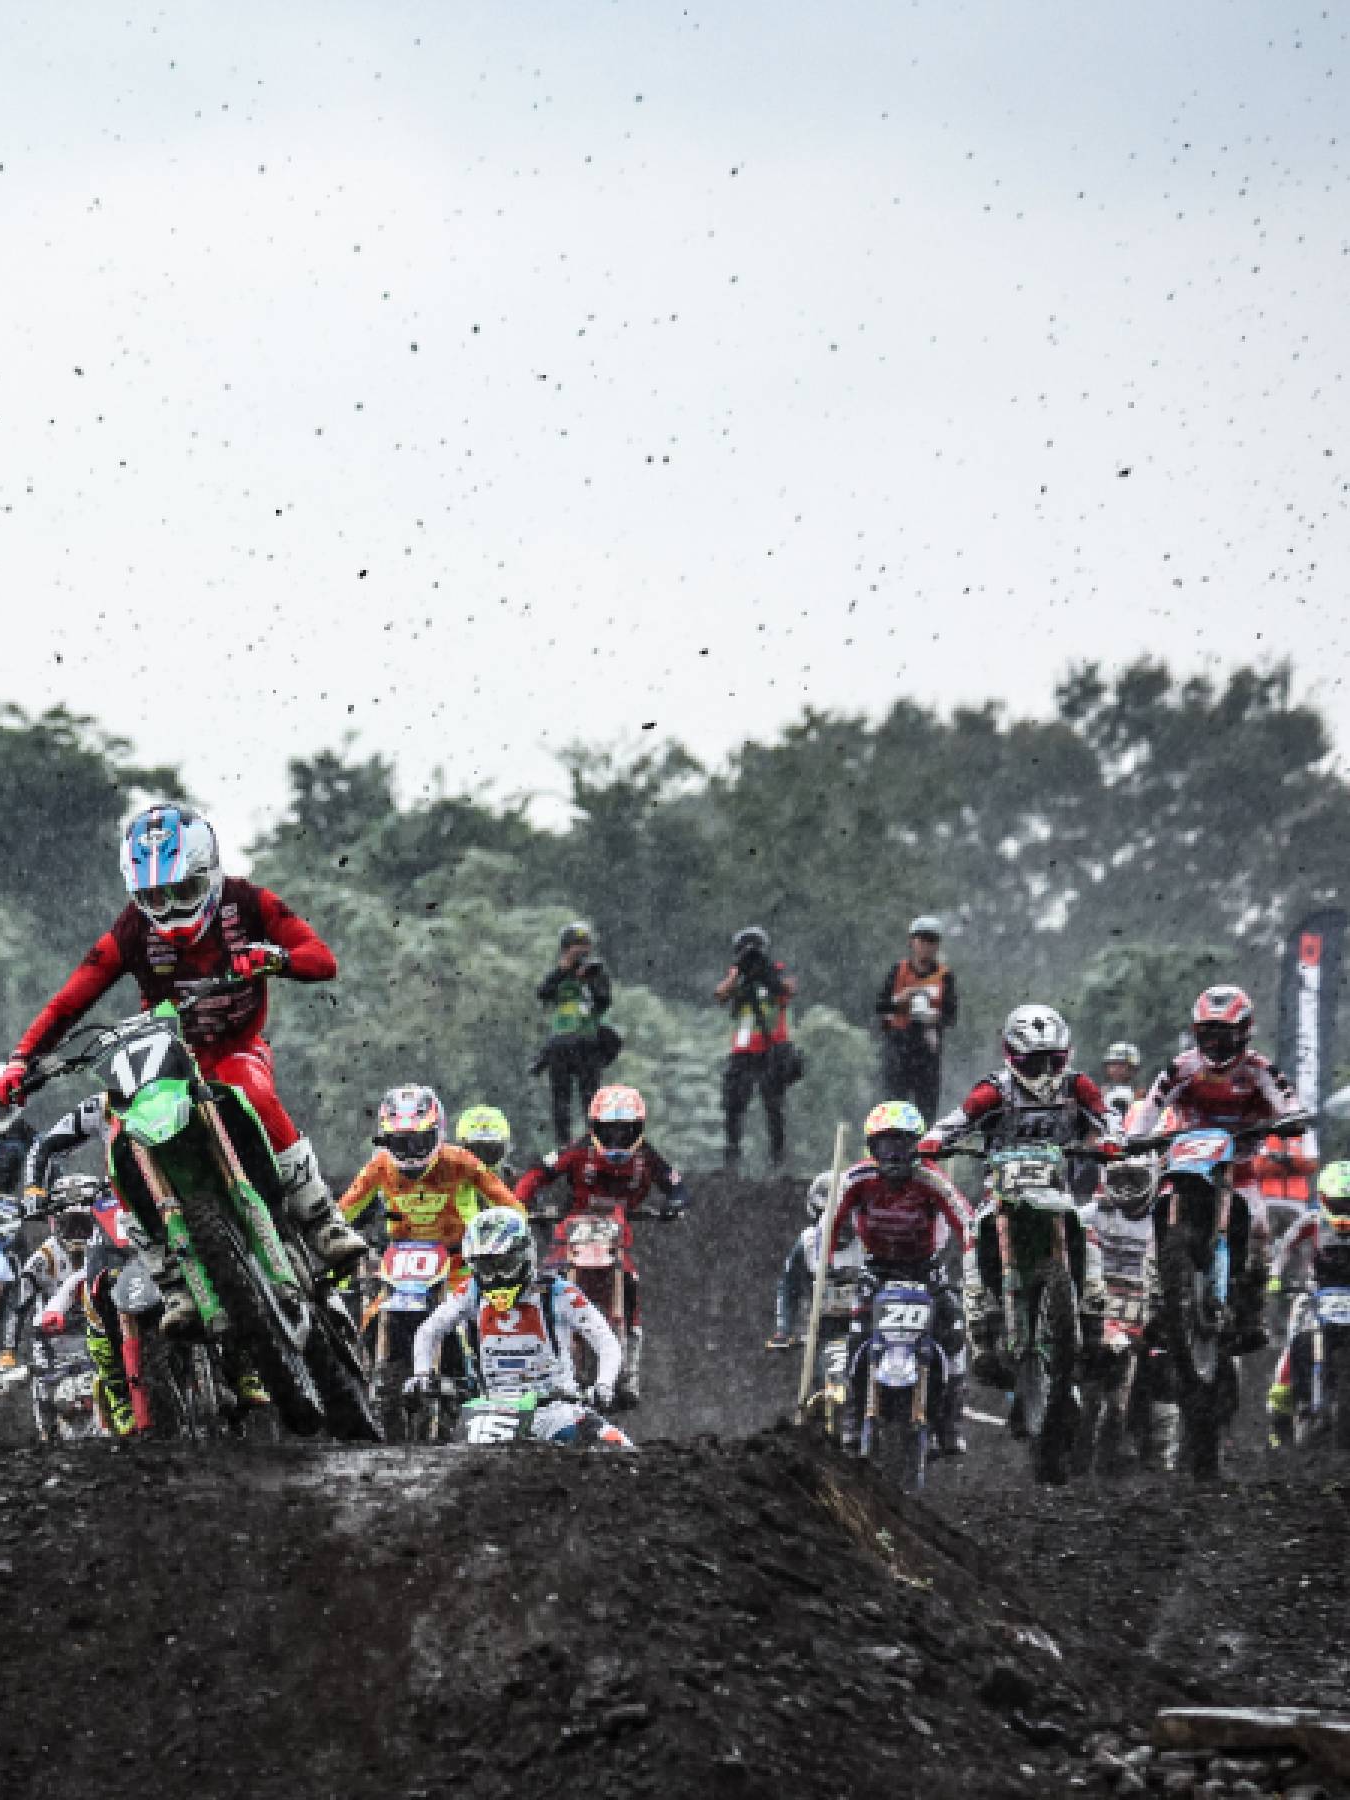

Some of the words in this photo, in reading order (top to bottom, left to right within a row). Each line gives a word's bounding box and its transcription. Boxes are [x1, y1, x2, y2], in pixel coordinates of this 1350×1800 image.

[110, 1032, 172, 1098] 17
[392, 1250, 440, 1280] 10
[879, 1303, 931, 1331] 20
